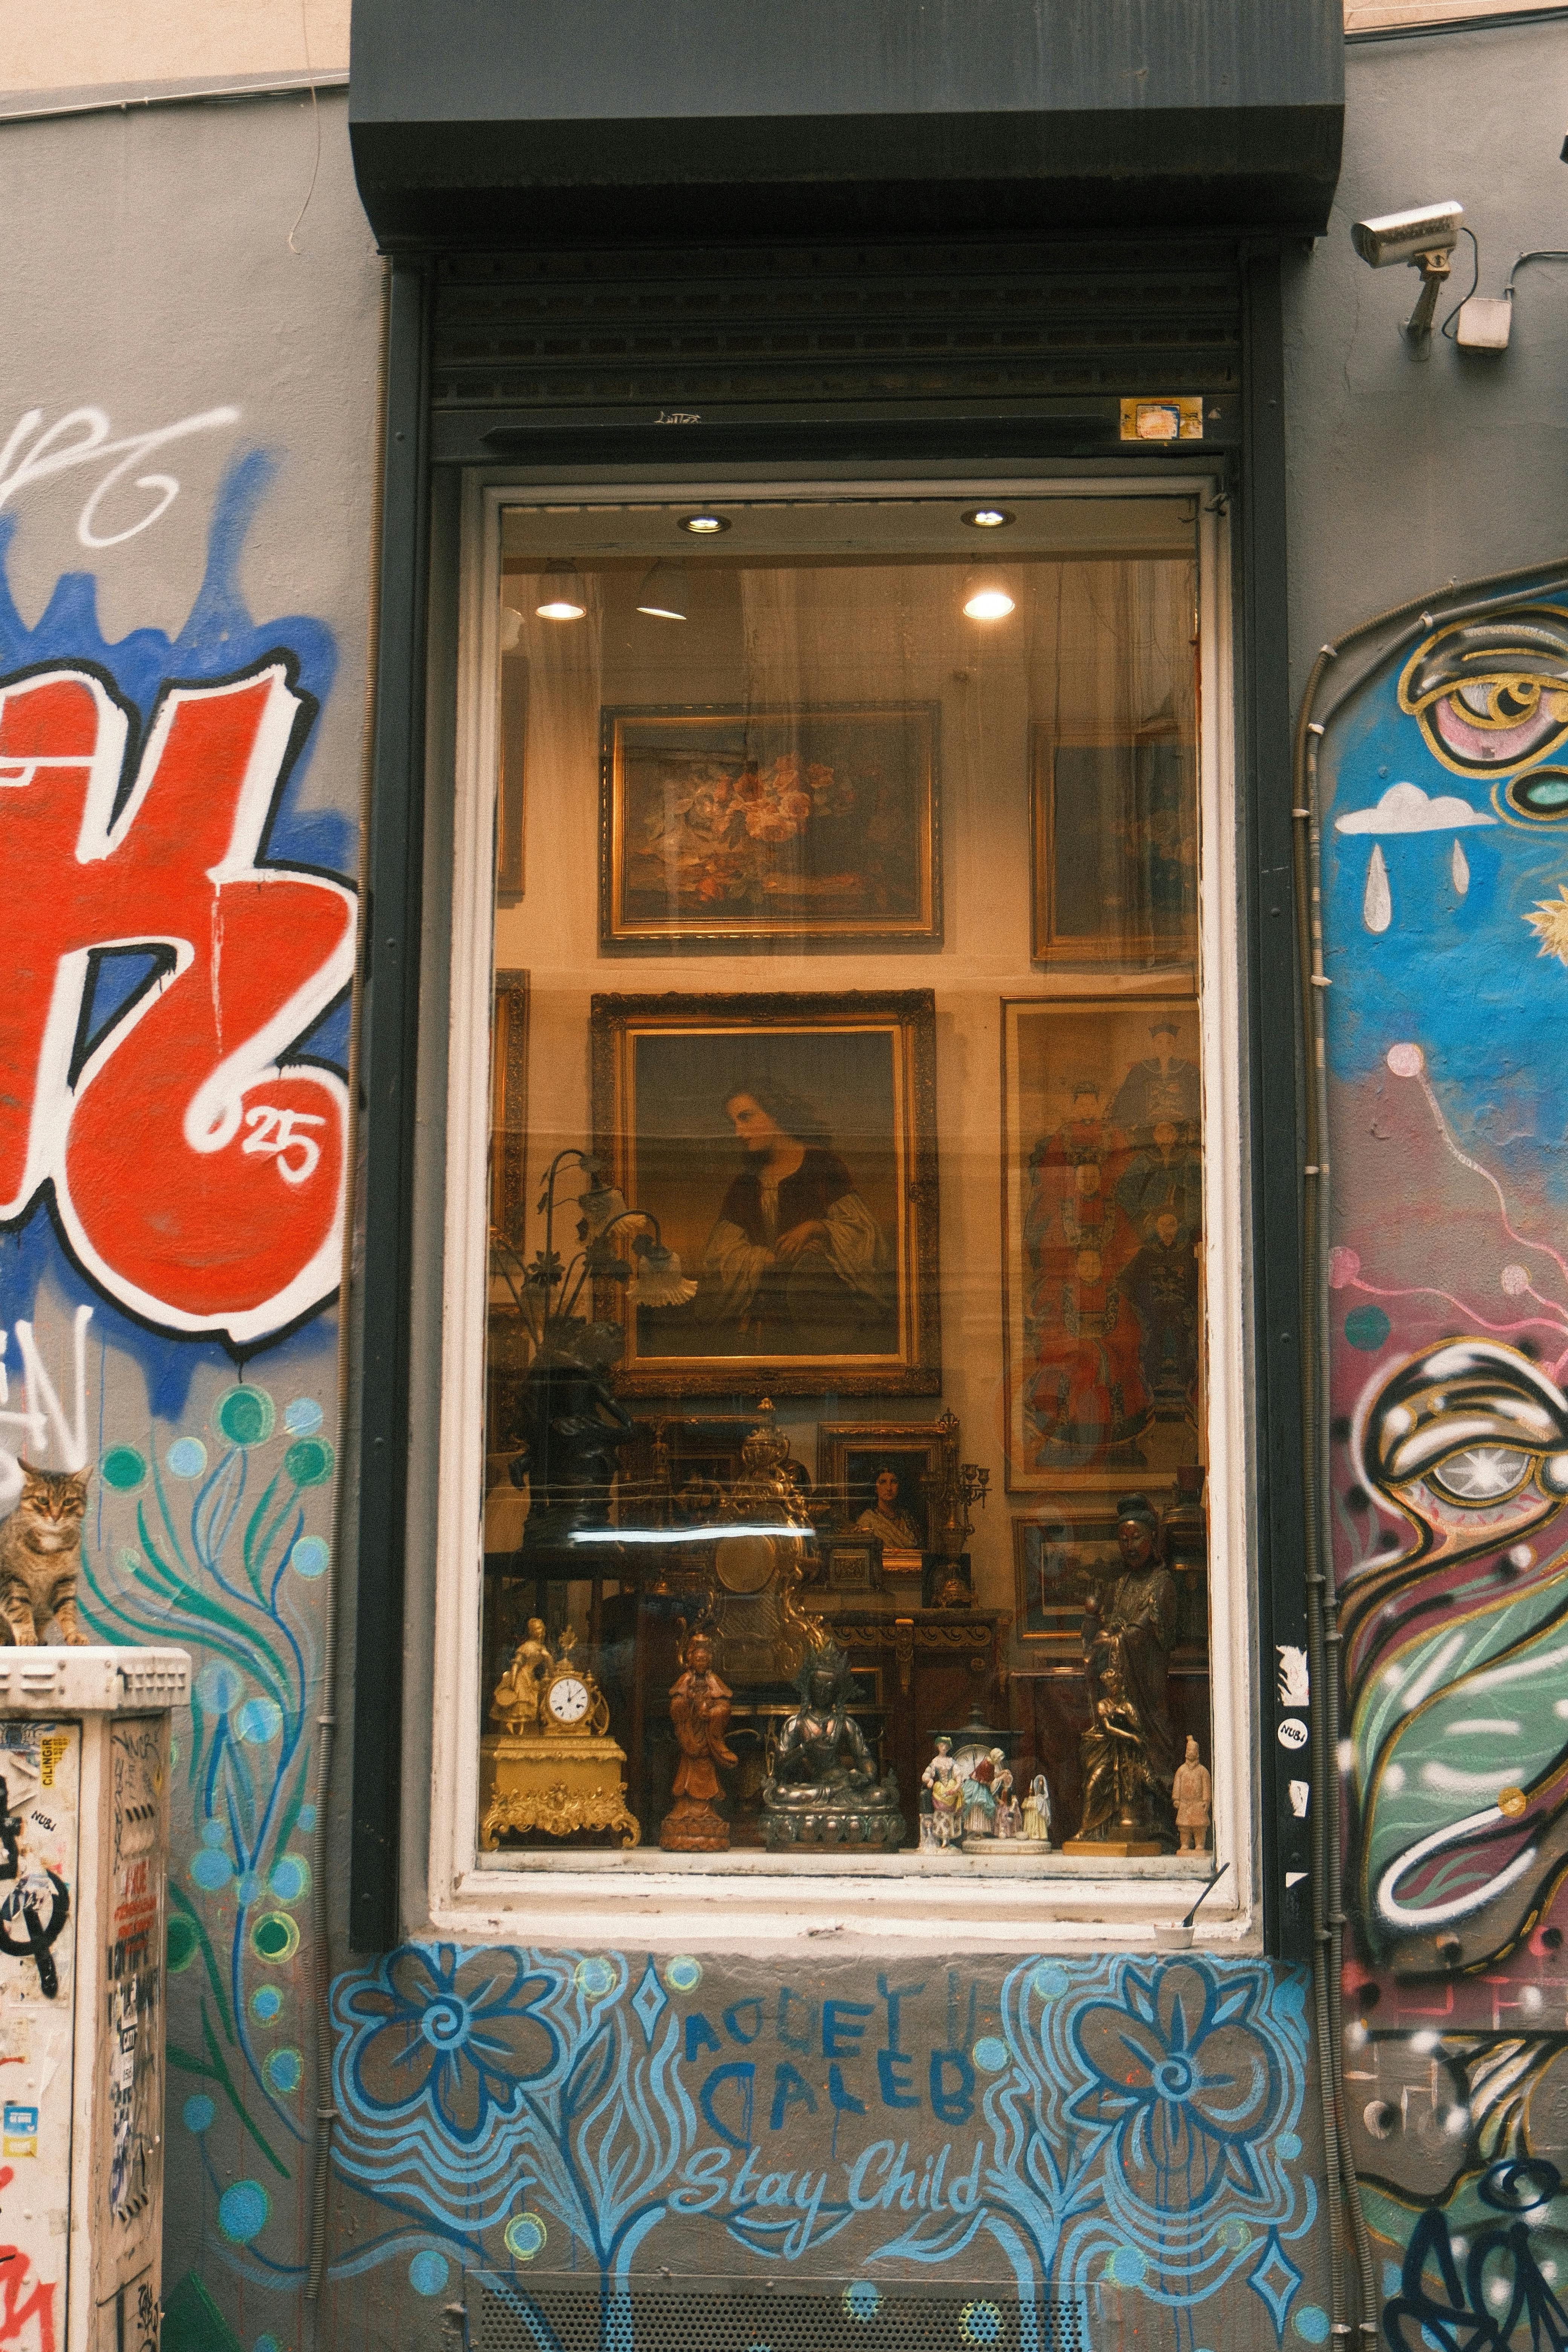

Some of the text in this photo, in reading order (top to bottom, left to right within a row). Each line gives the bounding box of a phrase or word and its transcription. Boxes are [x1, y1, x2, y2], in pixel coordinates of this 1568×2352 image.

[241, 1105, 326, 1185] 25
[668, 2139, 983, 2261] Stay Child
